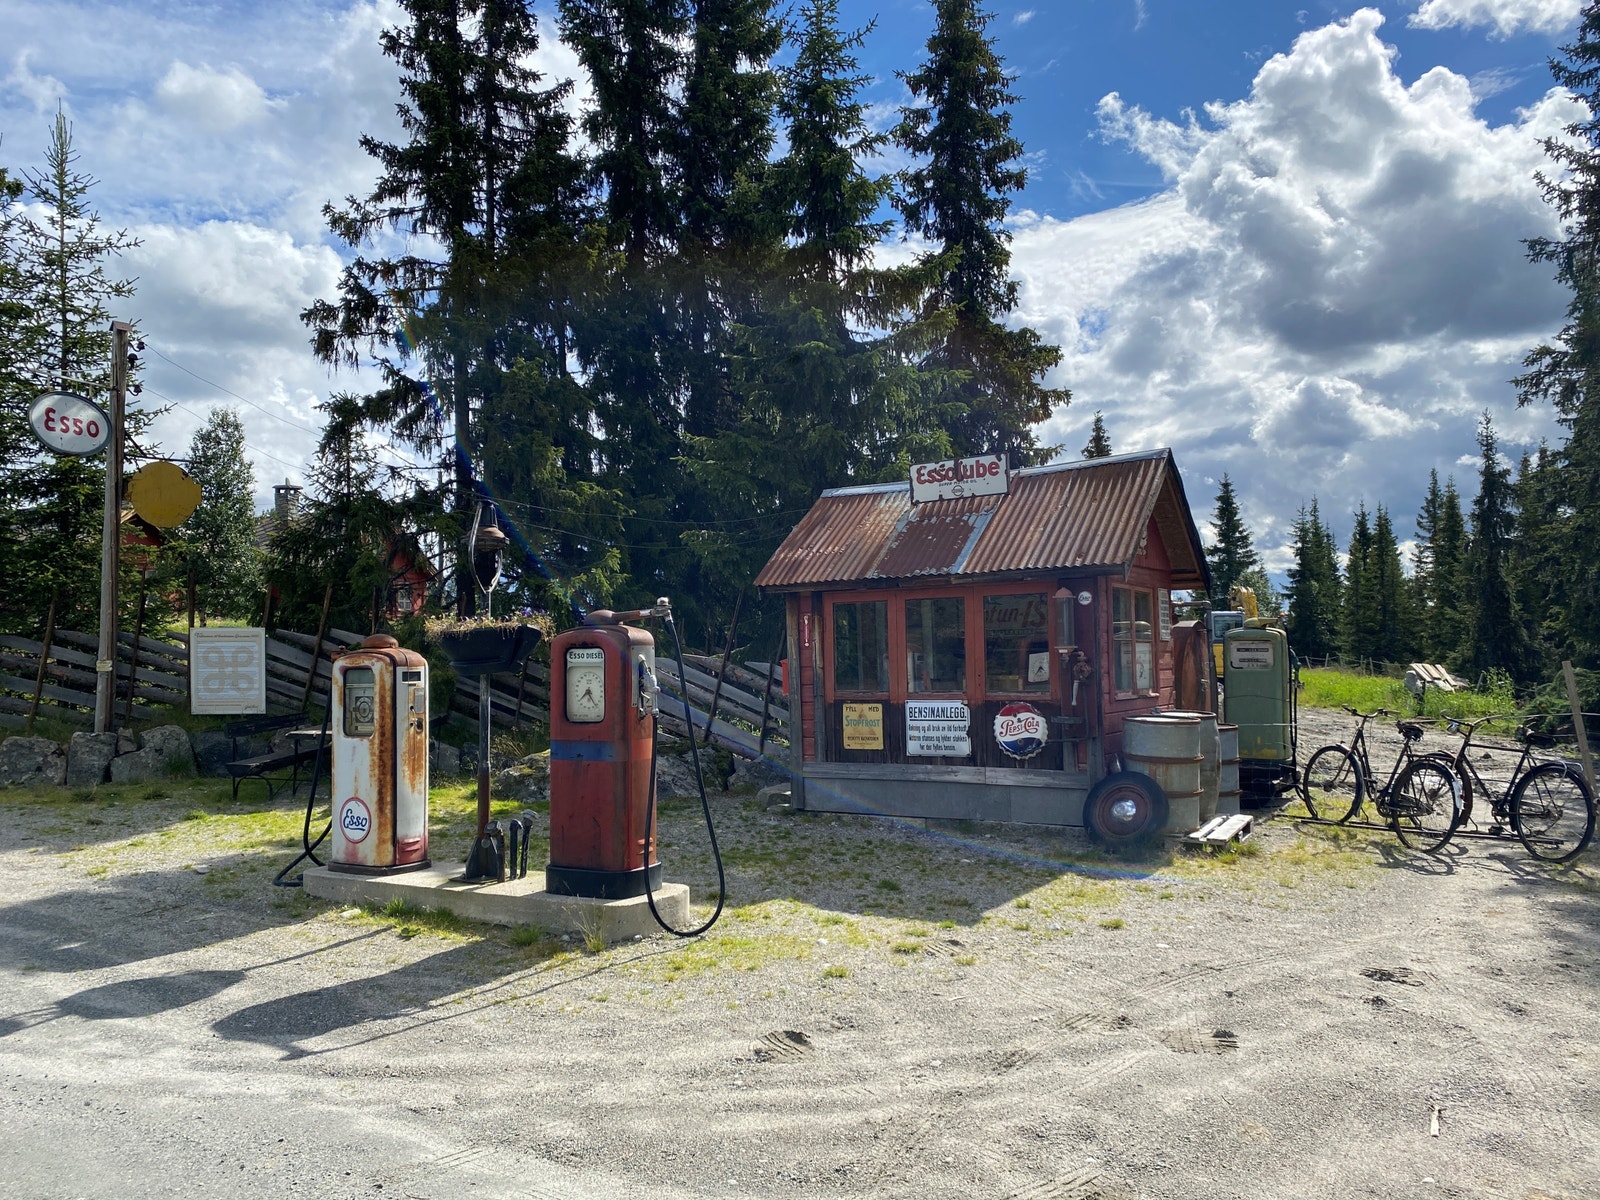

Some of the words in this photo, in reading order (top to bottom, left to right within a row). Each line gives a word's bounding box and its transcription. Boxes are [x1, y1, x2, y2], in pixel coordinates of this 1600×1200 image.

[916, 460, 1000, 485] Essolube
[908, 706, 967, 719] BENSINANLEGG.
[343, 808, 368, 830] Esso
